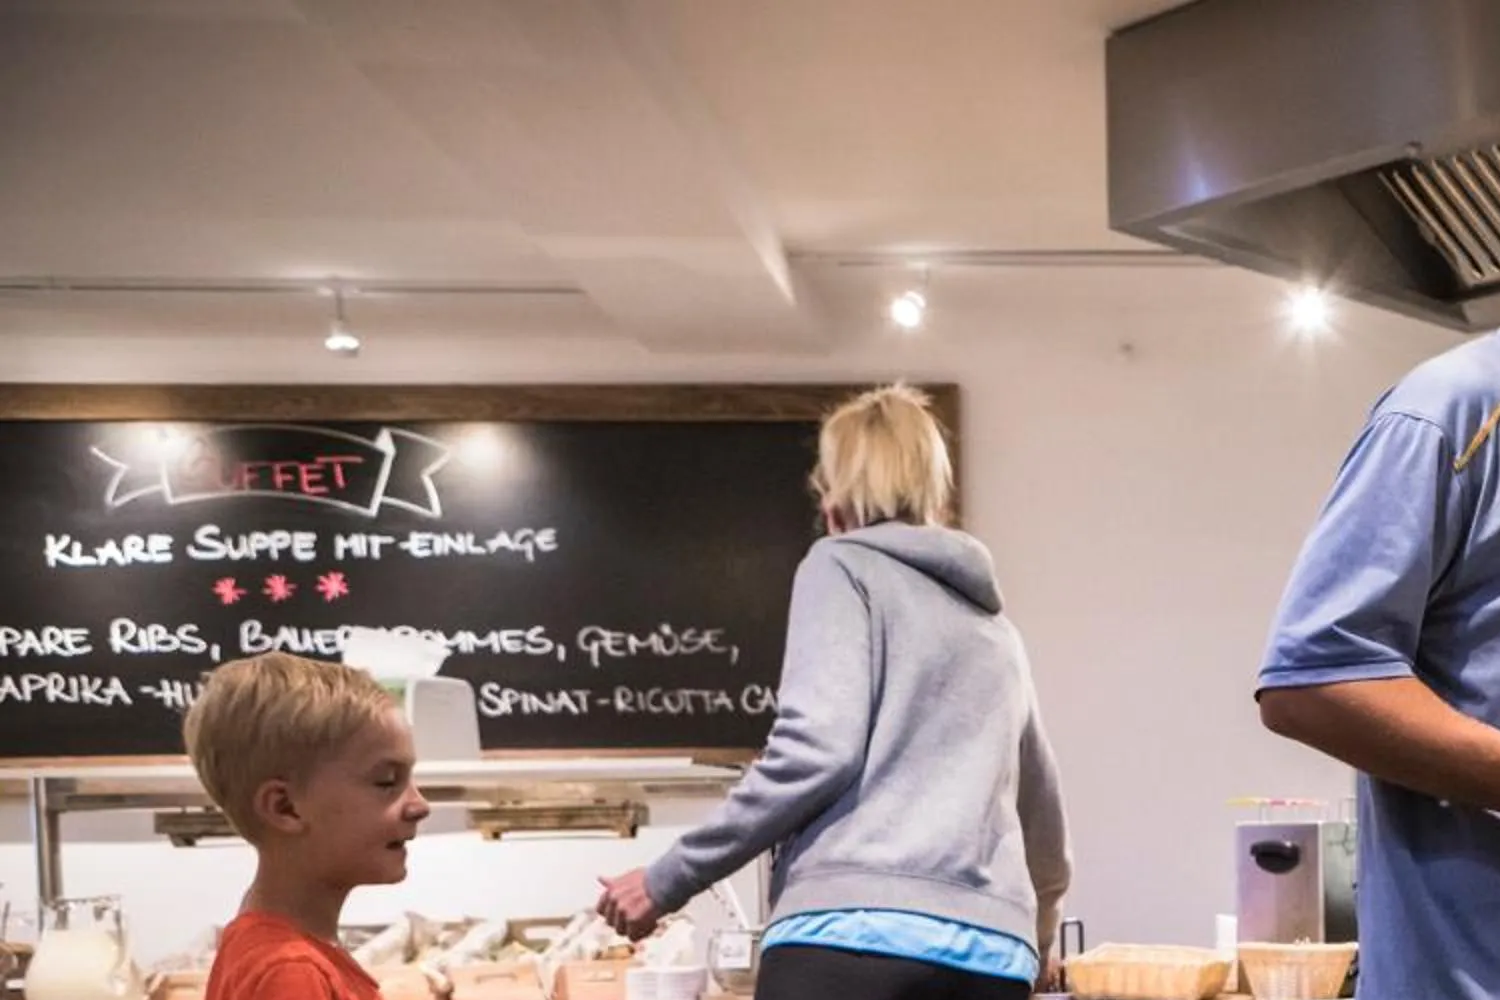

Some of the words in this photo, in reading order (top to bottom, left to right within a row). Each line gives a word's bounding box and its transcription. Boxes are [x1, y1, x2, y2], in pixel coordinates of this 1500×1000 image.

[44, 533, 175, 568] KLARE
[186, 524, 318, 561] SUPPE
[334, 533, 396, 560] MIT
[108, 617, 221, 662] RIBS,
